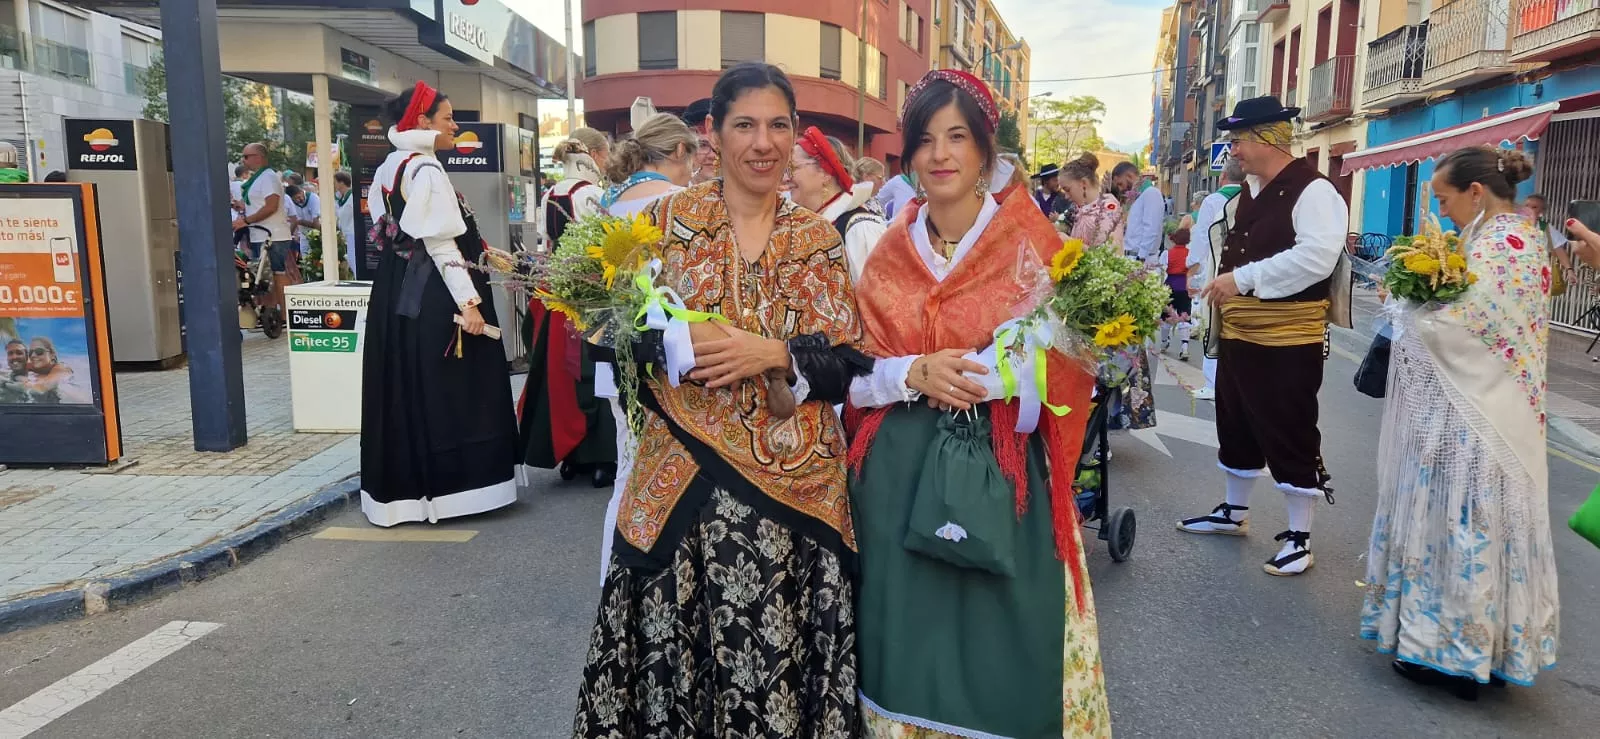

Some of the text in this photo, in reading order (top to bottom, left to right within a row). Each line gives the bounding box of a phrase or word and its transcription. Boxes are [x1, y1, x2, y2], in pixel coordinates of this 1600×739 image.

[449, 11, 489, 53] REPSOL
[81, 154, 125, 163] REPSOL
[447, 157, 488, 165] REPSOL
[7, 217, 20, 228] te
[24, 217, 58, 228] sienta
[18, 229, 45, 241] más!
[290, 297, 332, 307] Servicio
[293, 315, 322, 324] Diesel
[332, 336, 350, 349] 95
